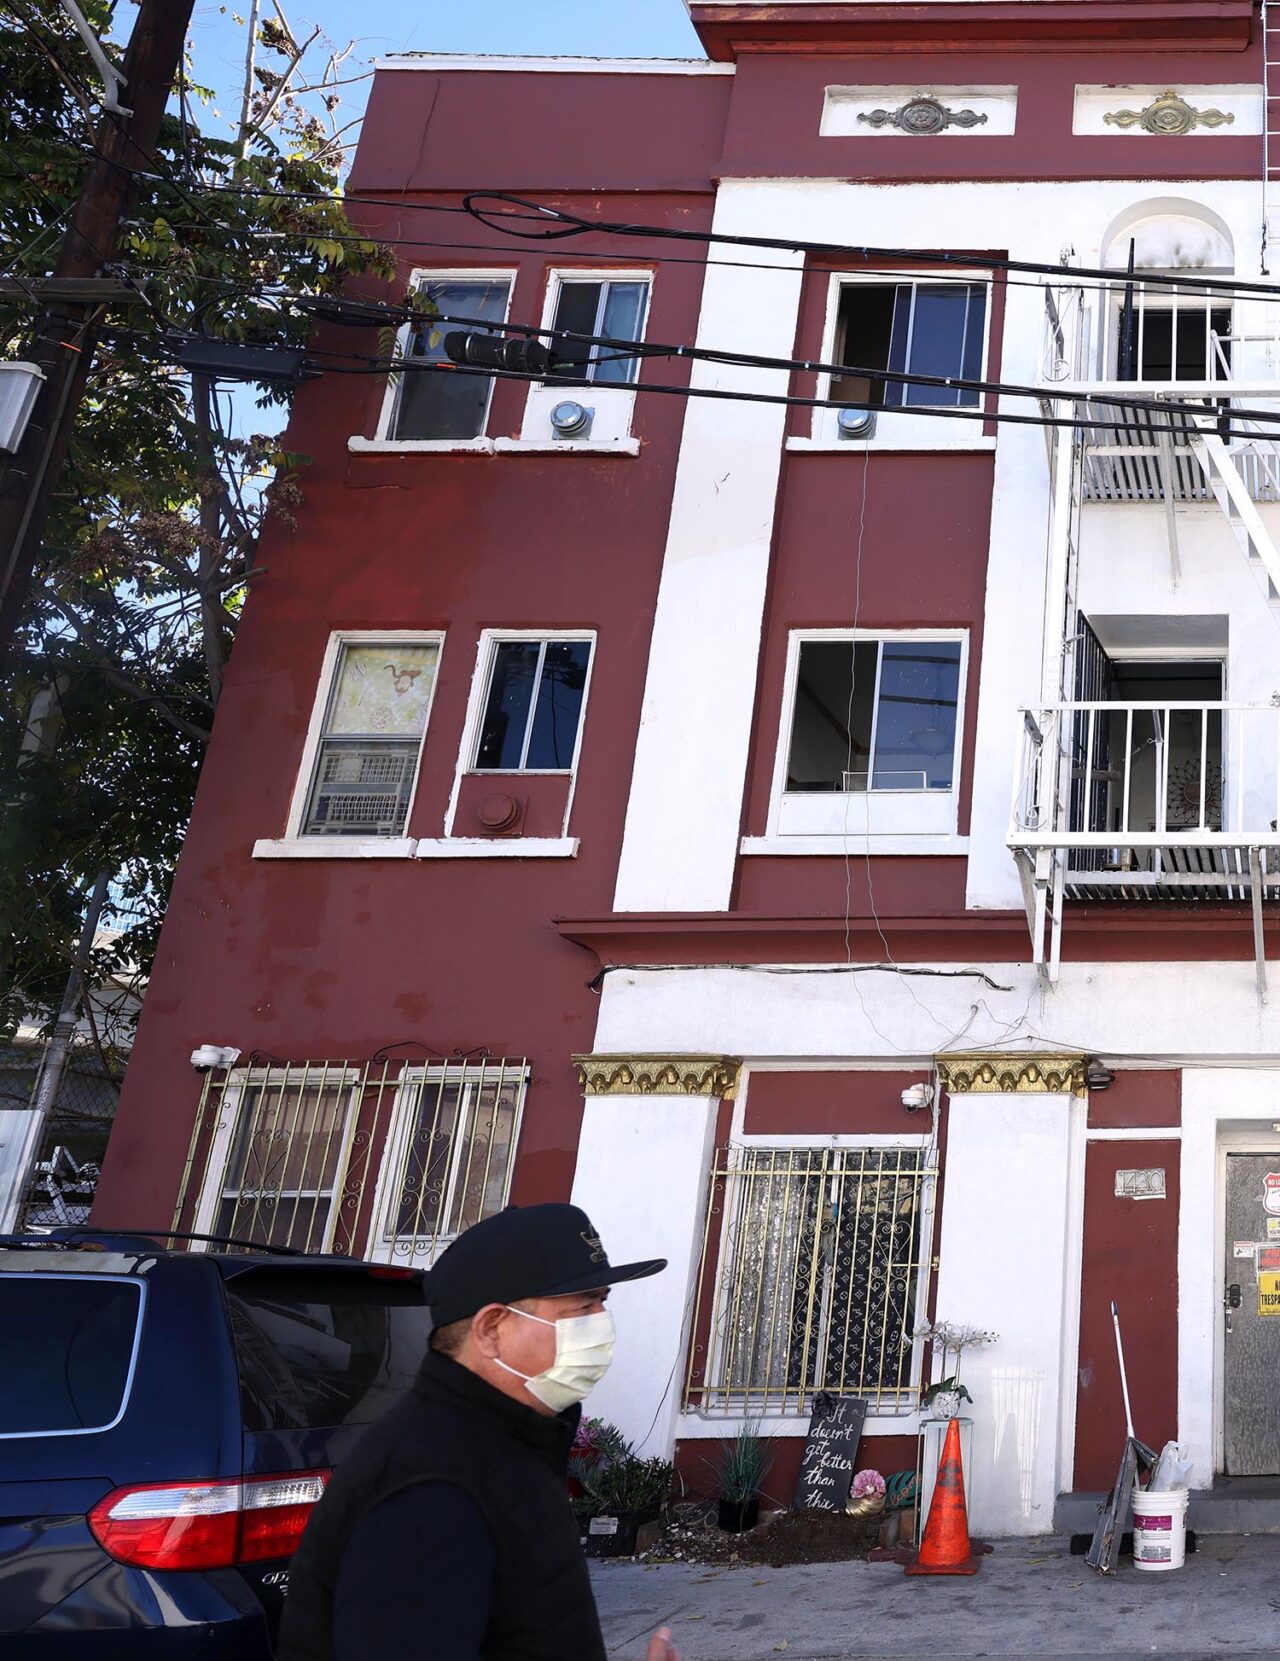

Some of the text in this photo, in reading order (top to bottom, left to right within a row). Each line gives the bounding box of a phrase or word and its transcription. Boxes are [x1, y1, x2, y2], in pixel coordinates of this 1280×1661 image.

[1268, 1178, 1276, 1186] NO
[802, 1439, 830, 1465] get
[817, 1451, 853, 1470] better
[804, 1466, 835, 1487] than
[804, 1489, 835, 1510] this
